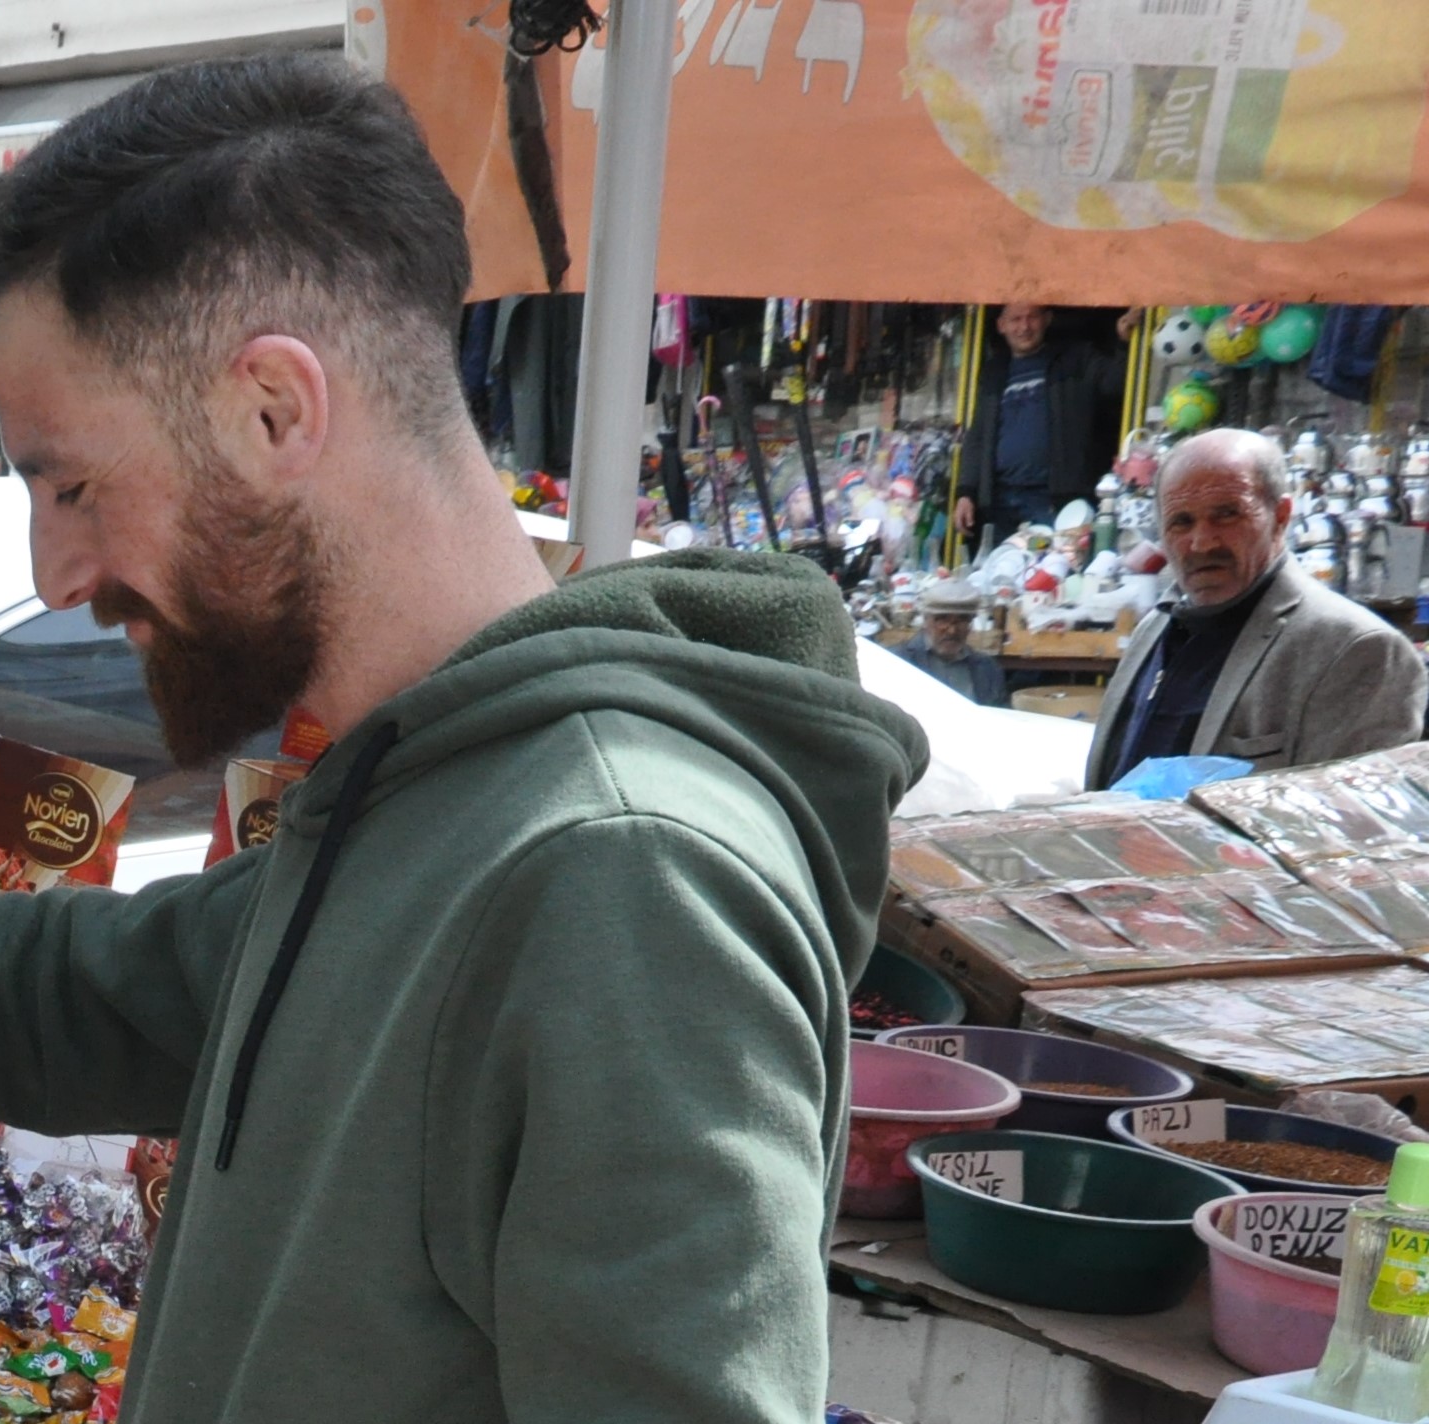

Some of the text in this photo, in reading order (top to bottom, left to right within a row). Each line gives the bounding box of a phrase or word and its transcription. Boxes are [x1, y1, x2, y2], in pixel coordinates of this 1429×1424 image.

[23, 792, 91, 832] Novien
[28, 828, 74, 853] Chocolates
[1142, 1105, 1191, 1134] PAZI
[1244, 1205, 1348, 1233] DOKUZ
